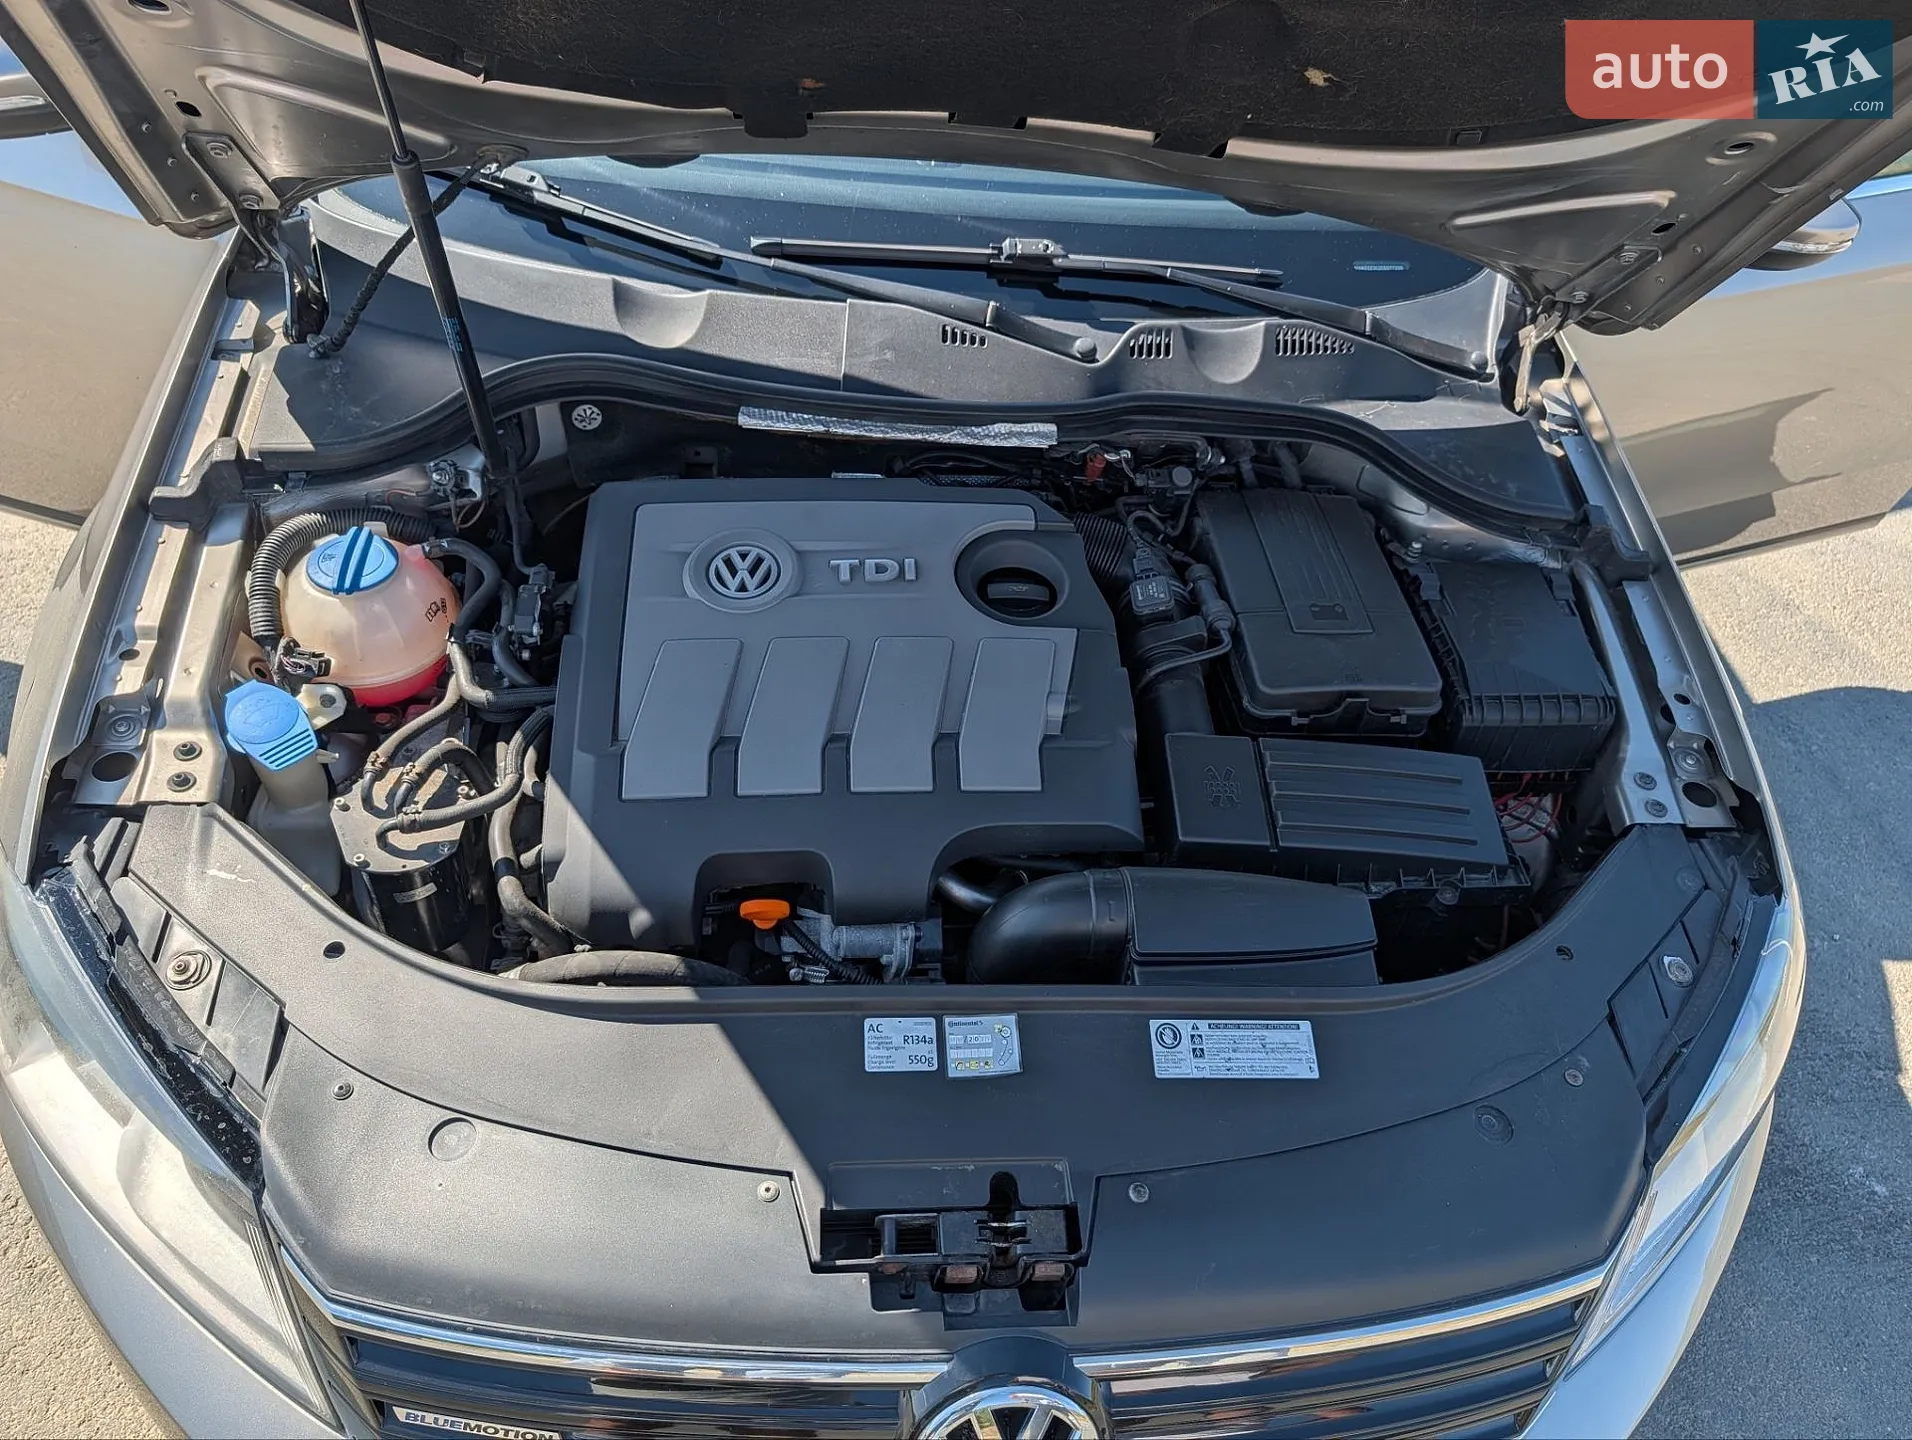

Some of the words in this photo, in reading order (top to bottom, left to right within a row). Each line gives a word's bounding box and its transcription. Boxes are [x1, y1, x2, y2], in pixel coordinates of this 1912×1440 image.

[829, 558, 917, 583] TDI
[867, 1023, 884, 1033] AC
[903, 1035, 933, 1045] R134a
[908, 1054, 934, 1068] 550g
[404, 1411, 554, 1440] BLUEMOTION
